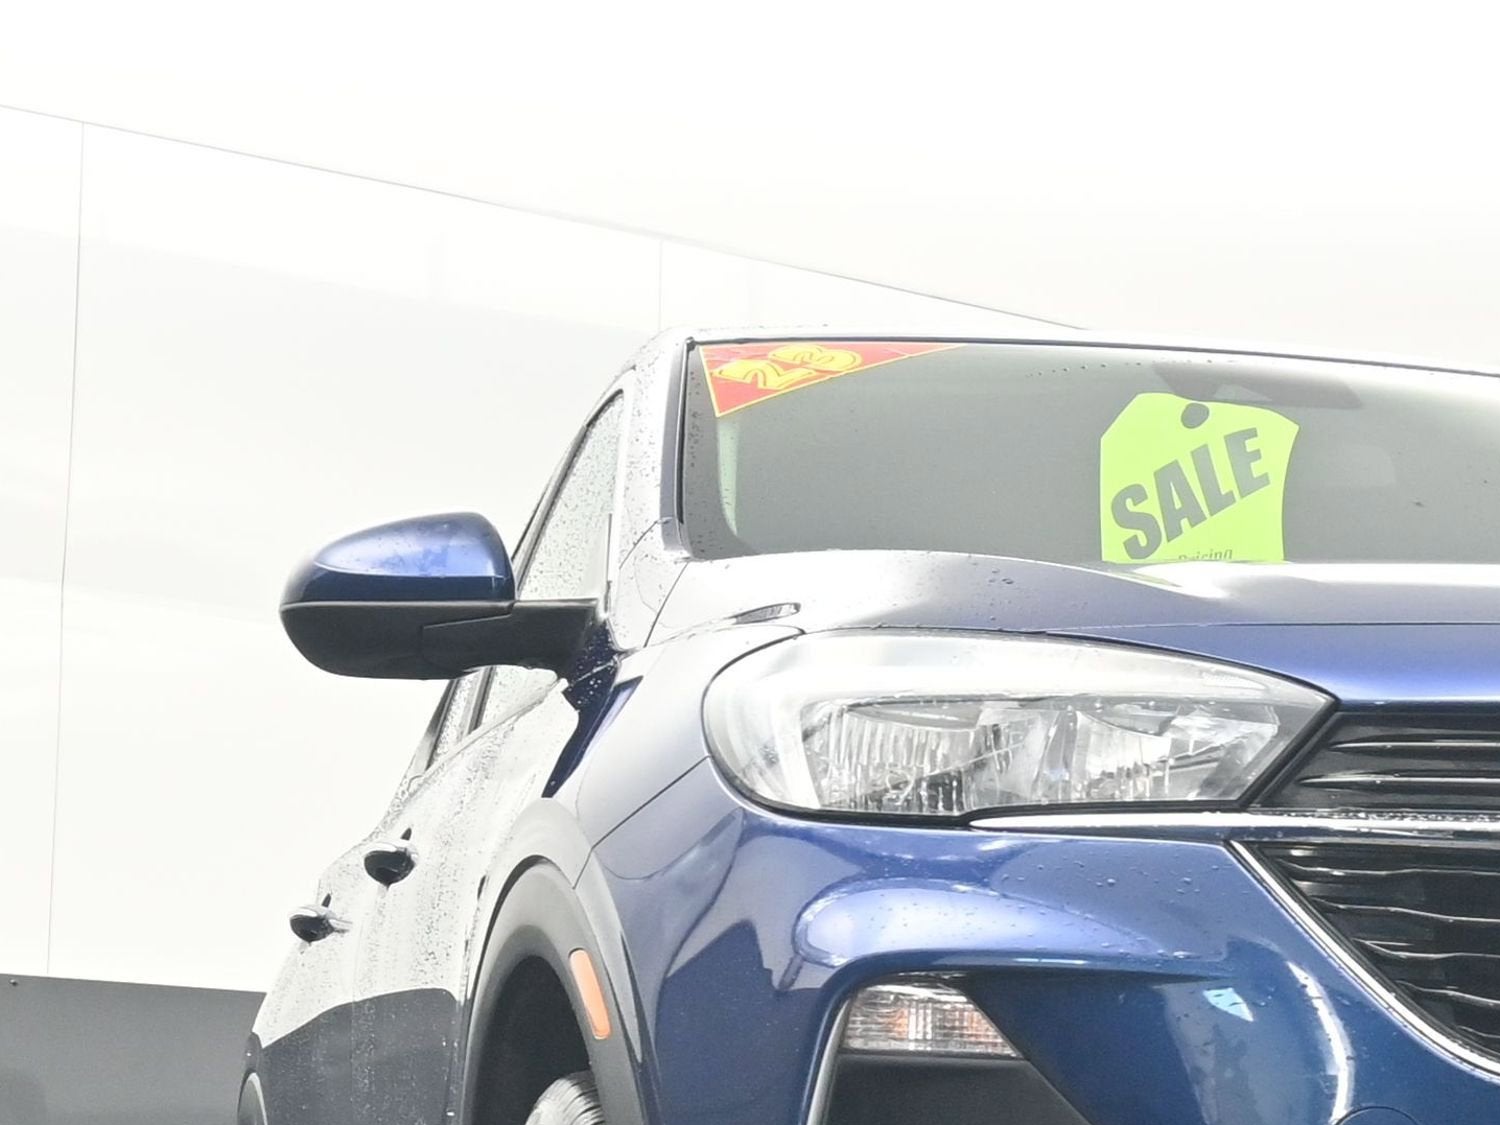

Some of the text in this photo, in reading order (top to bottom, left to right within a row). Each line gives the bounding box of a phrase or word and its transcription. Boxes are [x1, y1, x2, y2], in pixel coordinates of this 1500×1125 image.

[712, 344, 863, 390] 23
[1111, 427, 1271, 560] SALE
[1177, 548, 1233, 560] icing
